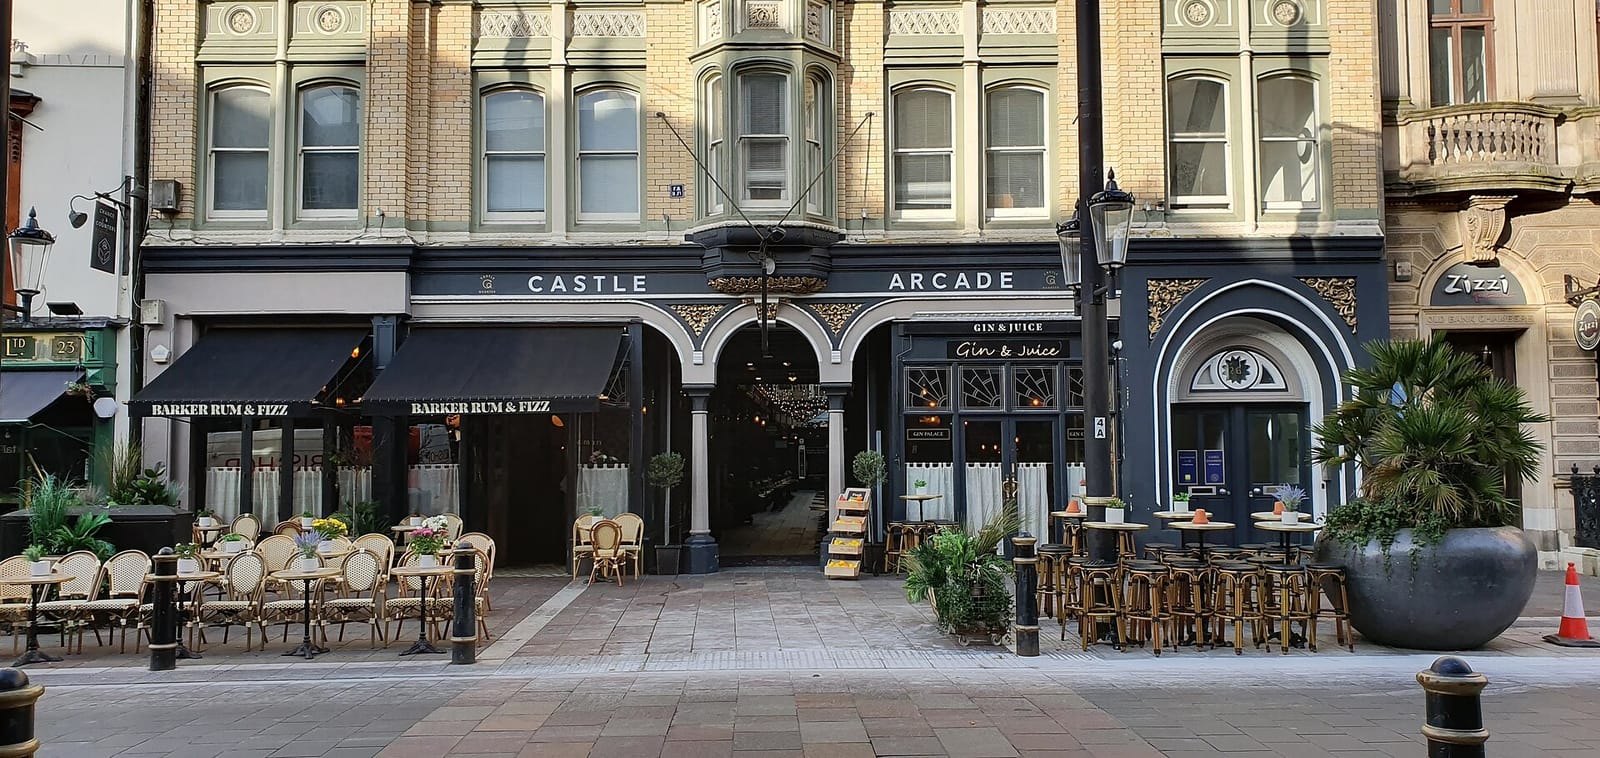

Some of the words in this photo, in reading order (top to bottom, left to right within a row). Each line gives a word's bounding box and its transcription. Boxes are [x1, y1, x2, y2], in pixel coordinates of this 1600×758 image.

[528, 275, 647, 292] CASTLE
[888, 272, 1014, 290] ARCADE
[1444, 274, 1509, 294] Zizzi
[973, 323, 995, 332] GIN
[998, 323, 1007, 332] &
[1009, 322, 1043, 333] JUICE
[1578, 319, 1599, 332] Zizzi
[57, 341, 76, 354] 23
[956, 341, 995, 358] Gin
[1000, 345, 1012, 357] &
[1017, 342, 1061, 356] Juice
[152, 404, 208, 416] BARKER
[211, 404, 243, 415] RUM
[244, 404, 255, 415] &
[257, 404, 289, 415] FIZZ
[411, 402, 469, 414] BARKER
[471, 401, 503, 413] RUM
[505, 402, 517, 413] &
[519, 401, 550, 412] FIZZ
[1096, 419, 1104, 427] 4
[1097, 428, 1105, 437] A
